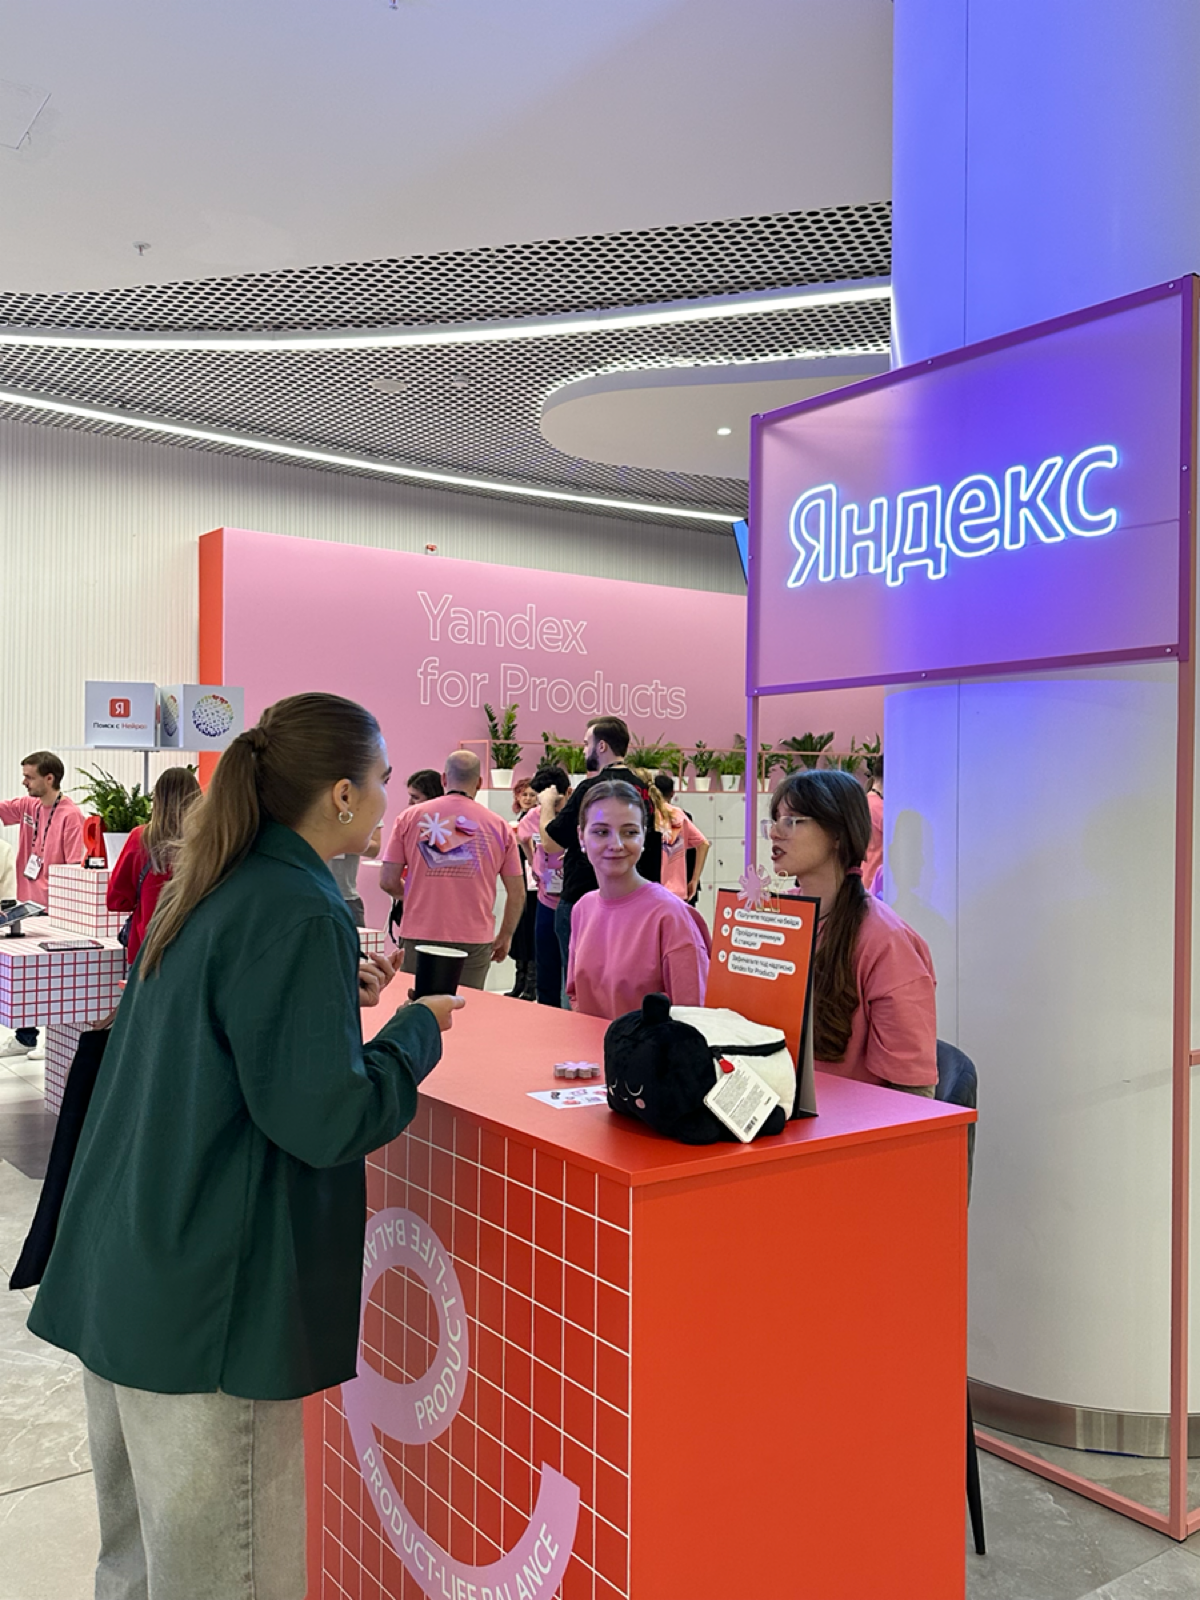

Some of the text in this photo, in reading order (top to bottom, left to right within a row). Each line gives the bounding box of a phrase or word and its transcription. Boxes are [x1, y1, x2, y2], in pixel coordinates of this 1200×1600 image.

[787, 444, 1118, 588] Яндекс
[417, 590, 588, 655] Yandex
[115, 702, 125, 715] Я
[417, 656, 688, 719] for Products
[363, 1219, 406, 1277] BALAN
